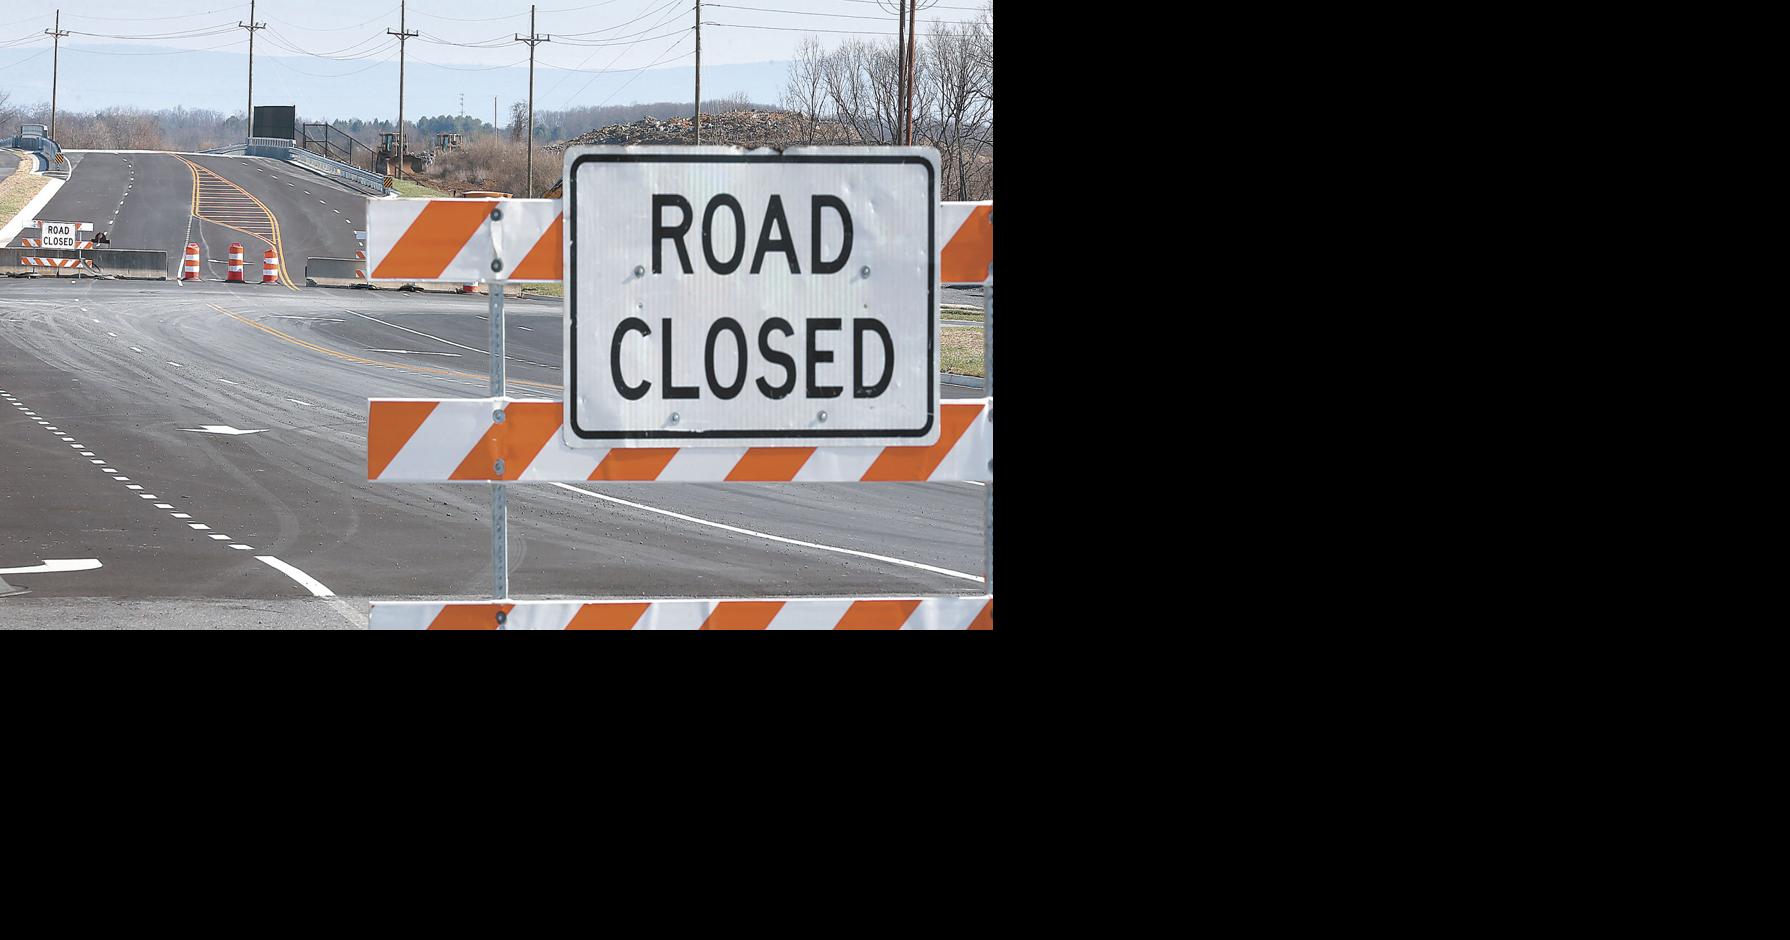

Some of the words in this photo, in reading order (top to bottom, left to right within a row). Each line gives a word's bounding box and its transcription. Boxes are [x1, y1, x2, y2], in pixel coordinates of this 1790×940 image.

[43, 236, 74, 246] CLOSED
[48, 225, 70, 235] ROAD
[651, 193, 854, 276] ROAD
[610, 316, 895, 401] CLOSED
